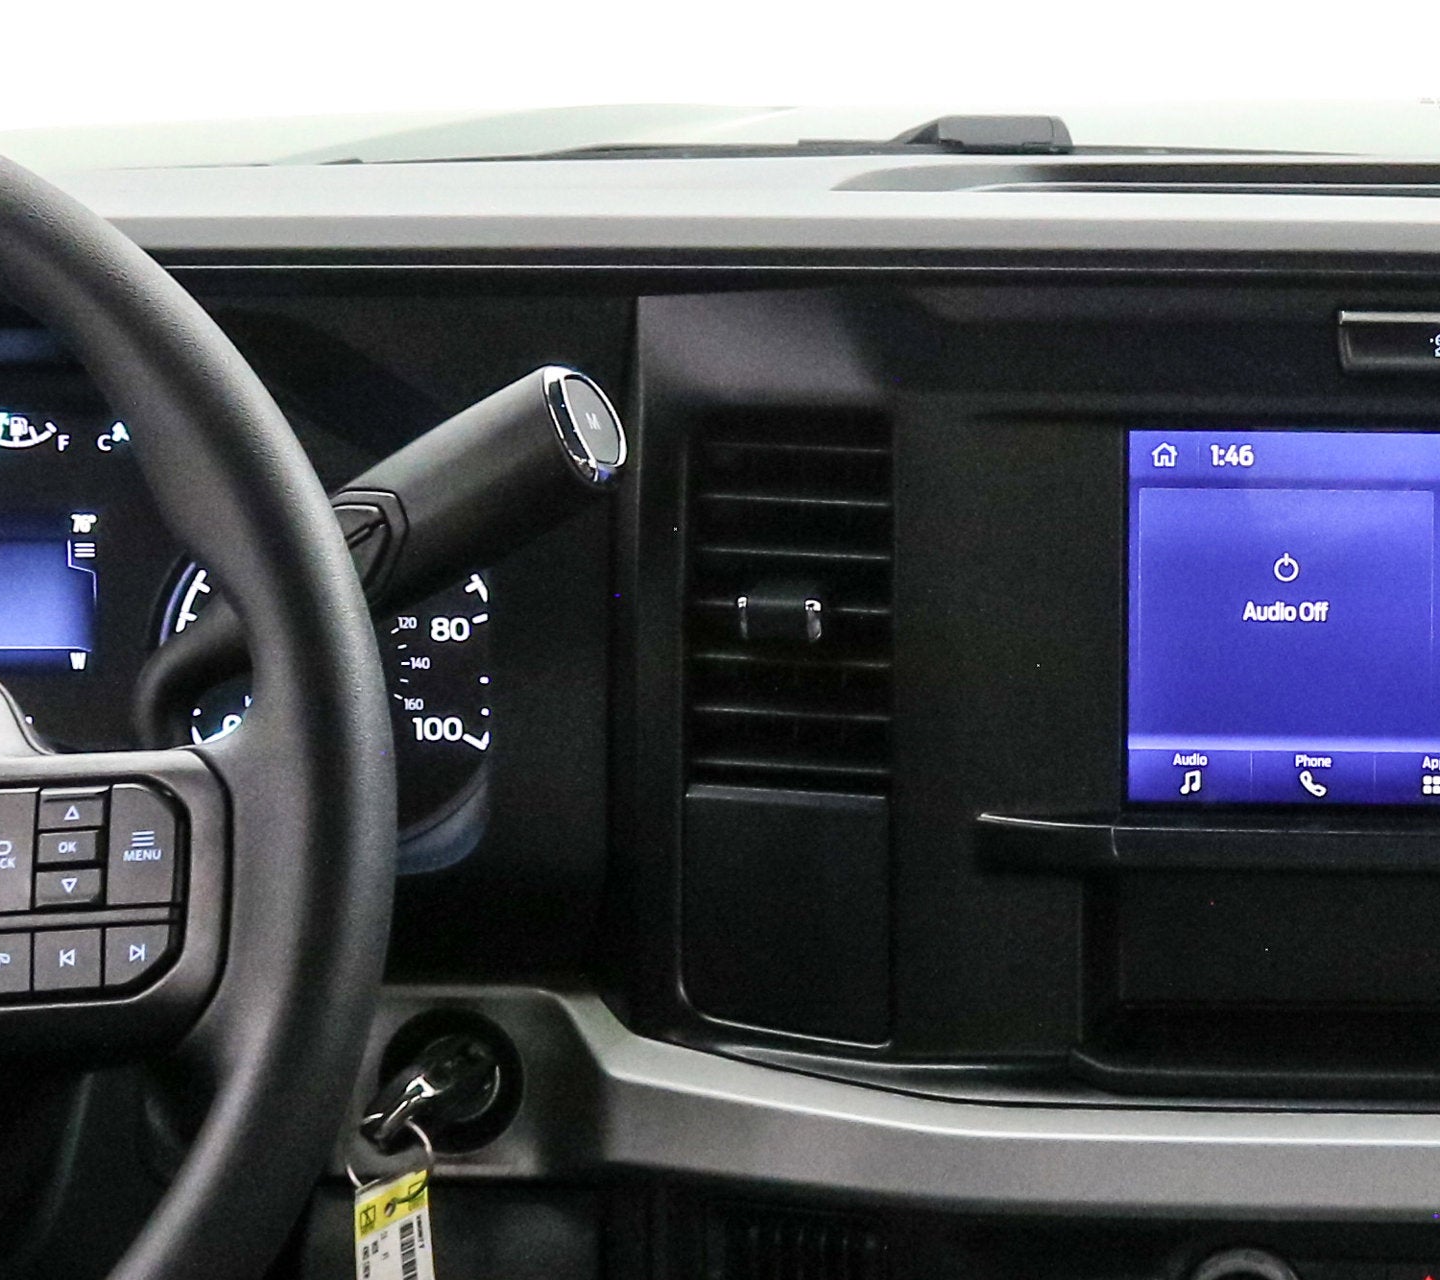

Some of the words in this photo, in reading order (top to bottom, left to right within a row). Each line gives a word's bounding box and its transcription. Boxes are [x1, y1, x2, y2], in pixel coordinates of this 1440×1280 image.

[585, 411, 601, 430] M
[58, 436, 70, 452] F
[98, 435, 110, 451] C
[1210, 443, 1255, 467] 1:46
[1242, 600, 1295, 621] Audio
[1298, 600, 1328, 621] Off
[398, 616, 417, 629] 120
[430, 617, 471, 642] 80
[70, 653, 87, 669] W
[409, 657, 430, 670] 140
[403, 698, 424, 711] 160
[412, 716, 463, 741] 100
[1173, 753, 1208, 768] Audio
[1295, 754, 1331, 769] Phone
[58, 841, 77, 854] OK
[123, 849, 162, 862] MENU
